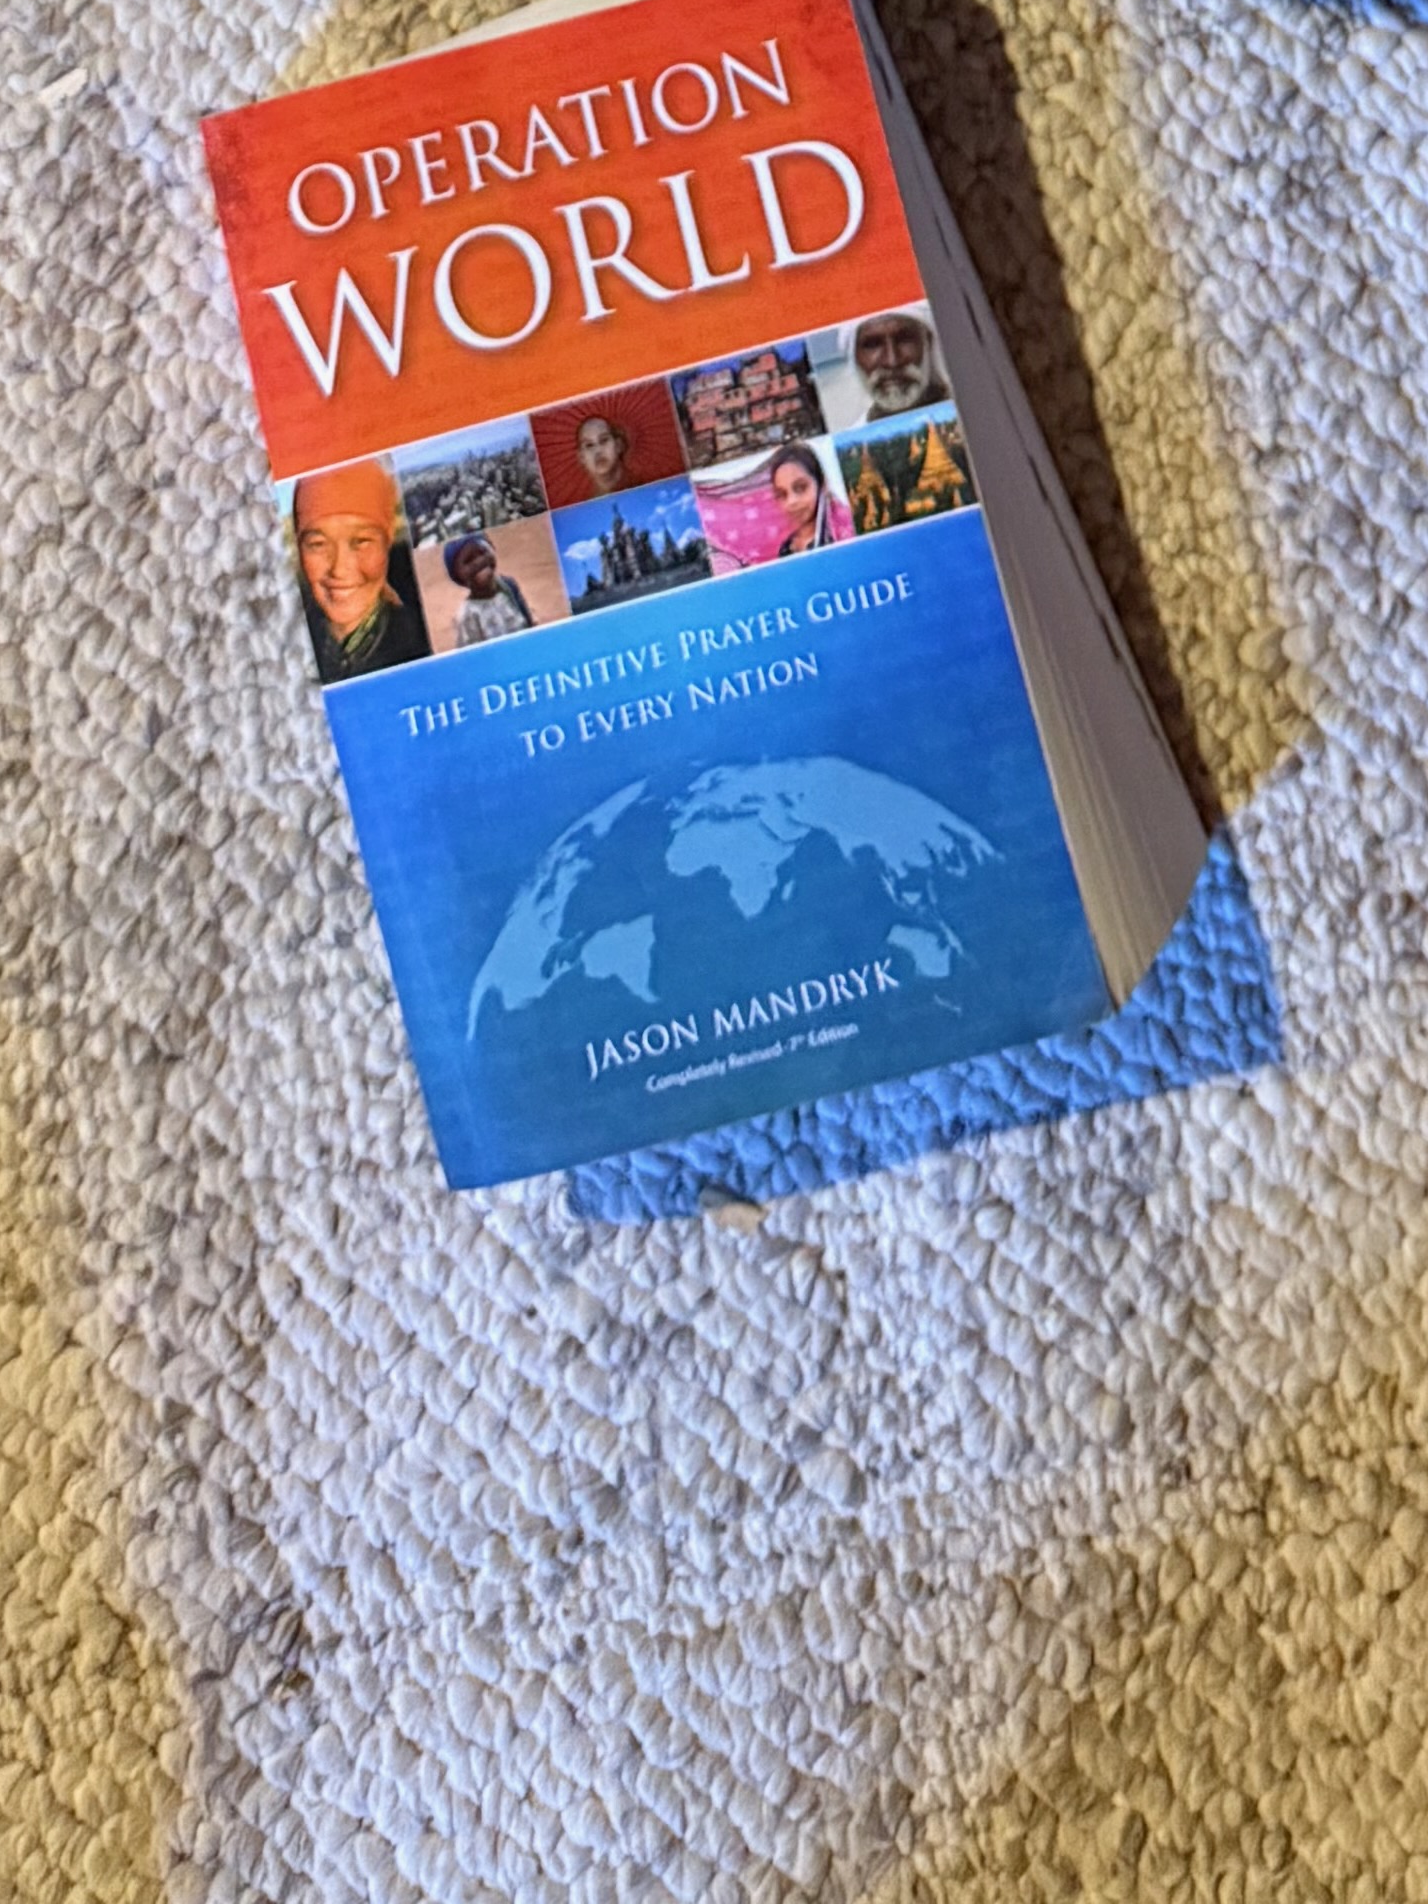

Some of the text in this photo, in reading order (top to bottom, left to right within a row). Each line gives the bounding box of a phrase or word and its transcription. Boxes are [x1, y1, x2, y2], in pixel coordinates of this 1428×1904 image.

[287, 37, 793, 241] OPERATION
[261, 138, 867, 400] WORLD
[399, 570, 917, 742] THE DEFINITIVE PRAYER GUIDE
[519, 651, 822, 761] TO EVERY NATION
[585, 957, 901, 1083] JASON MANDRYK
[644, 1058, 728, 1094] Completely
